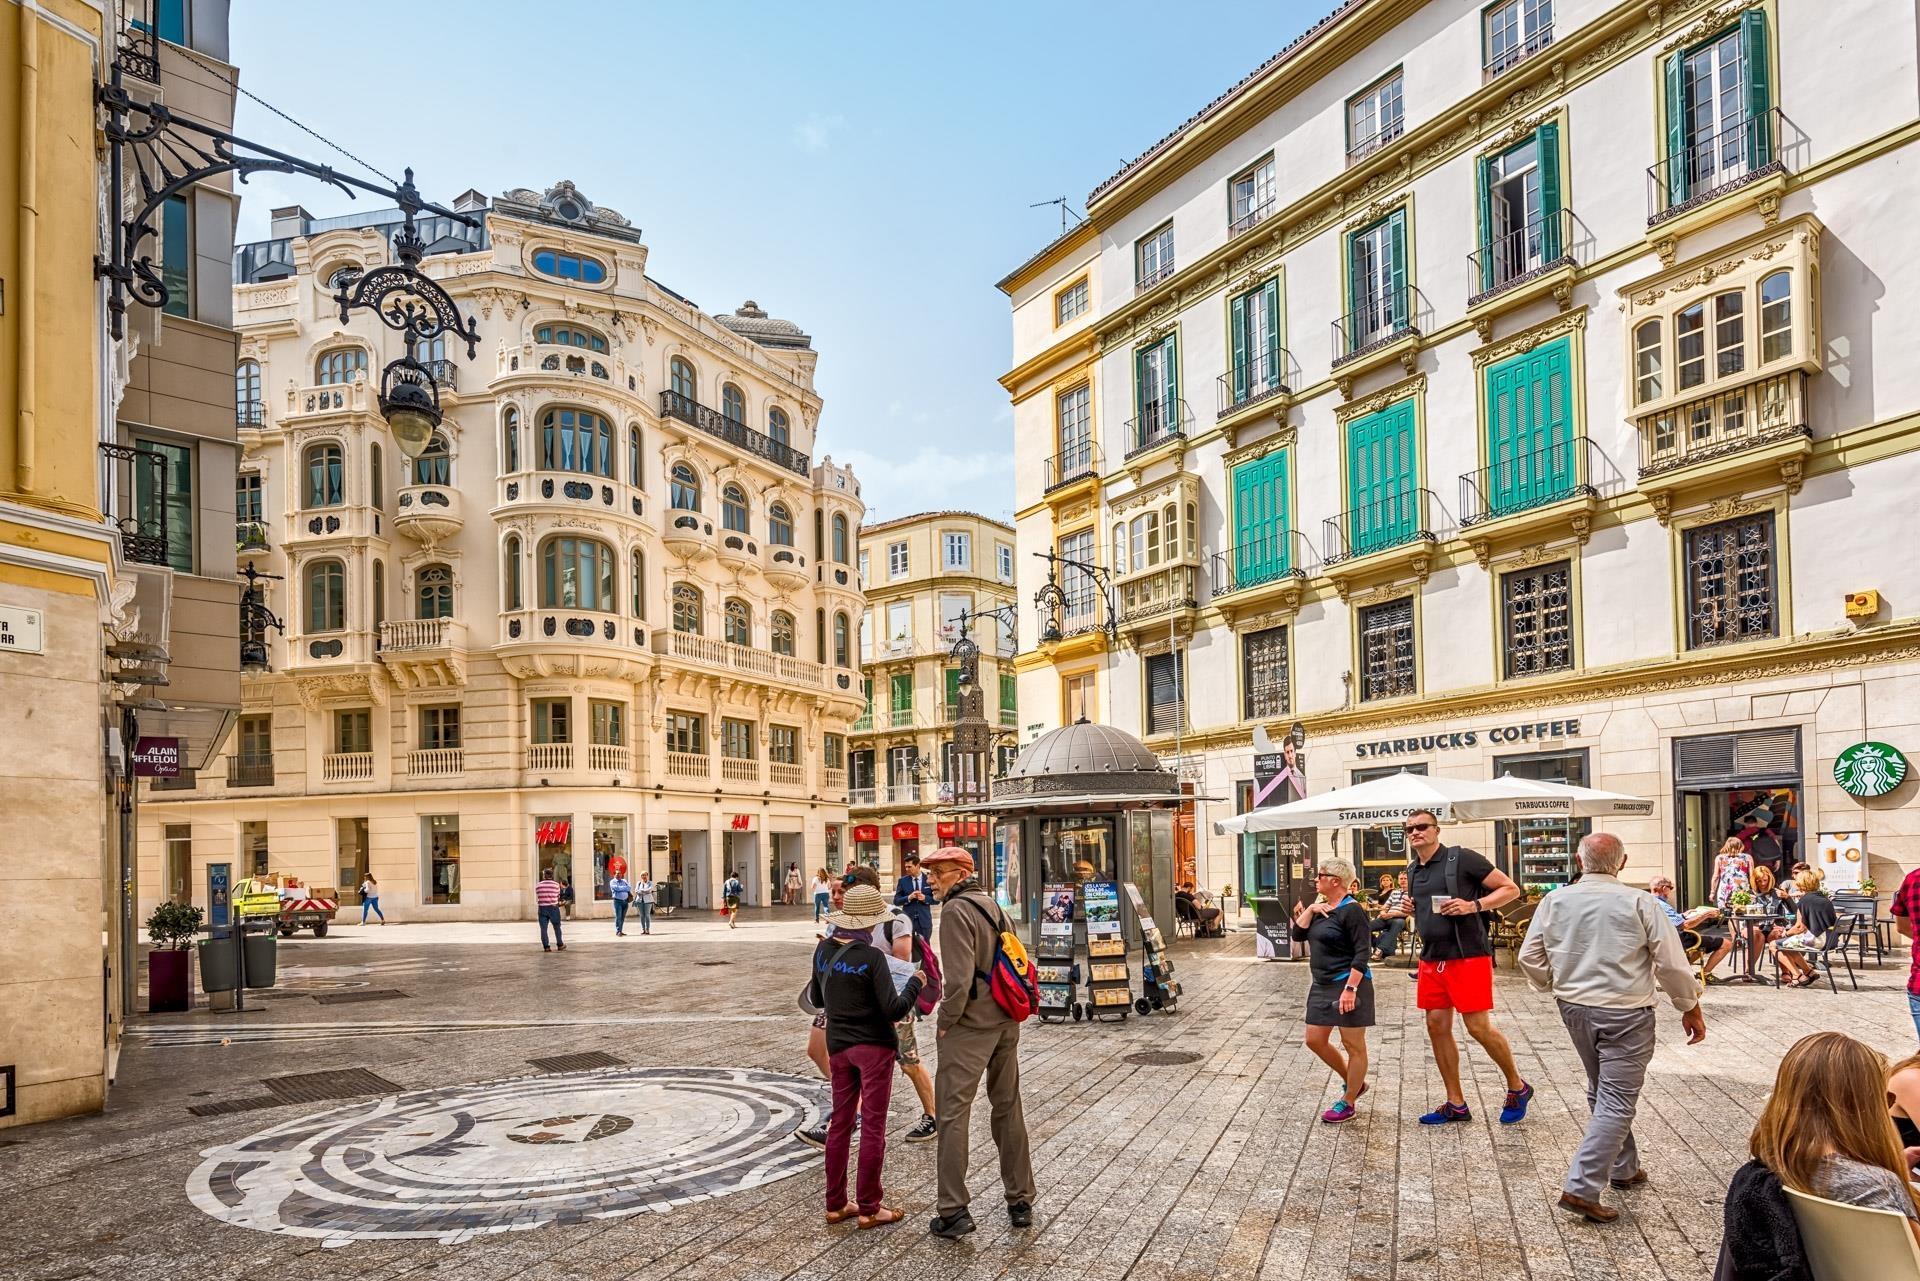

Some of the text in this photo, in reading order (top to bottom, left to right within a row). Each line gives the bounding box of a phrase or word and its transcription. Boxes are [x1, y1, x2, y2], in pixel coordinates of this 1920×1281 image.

[0, 620, 8, 632] A
[1, 633, 15, 645] AR
[1356, 718, 1580, 758] STARBUCKS COFFEE
[147, 747, 177, 755] ALAIN
[1515, 800, 1569, 810] STARBUCKS COFFEE
[1613, 803, 1635, 811] STARBUCKS
[1339, 809, 1399, 820] STARBUCKS
[731, 815, 750, 830] H&M
[536, 821, 571, 845] H&M
